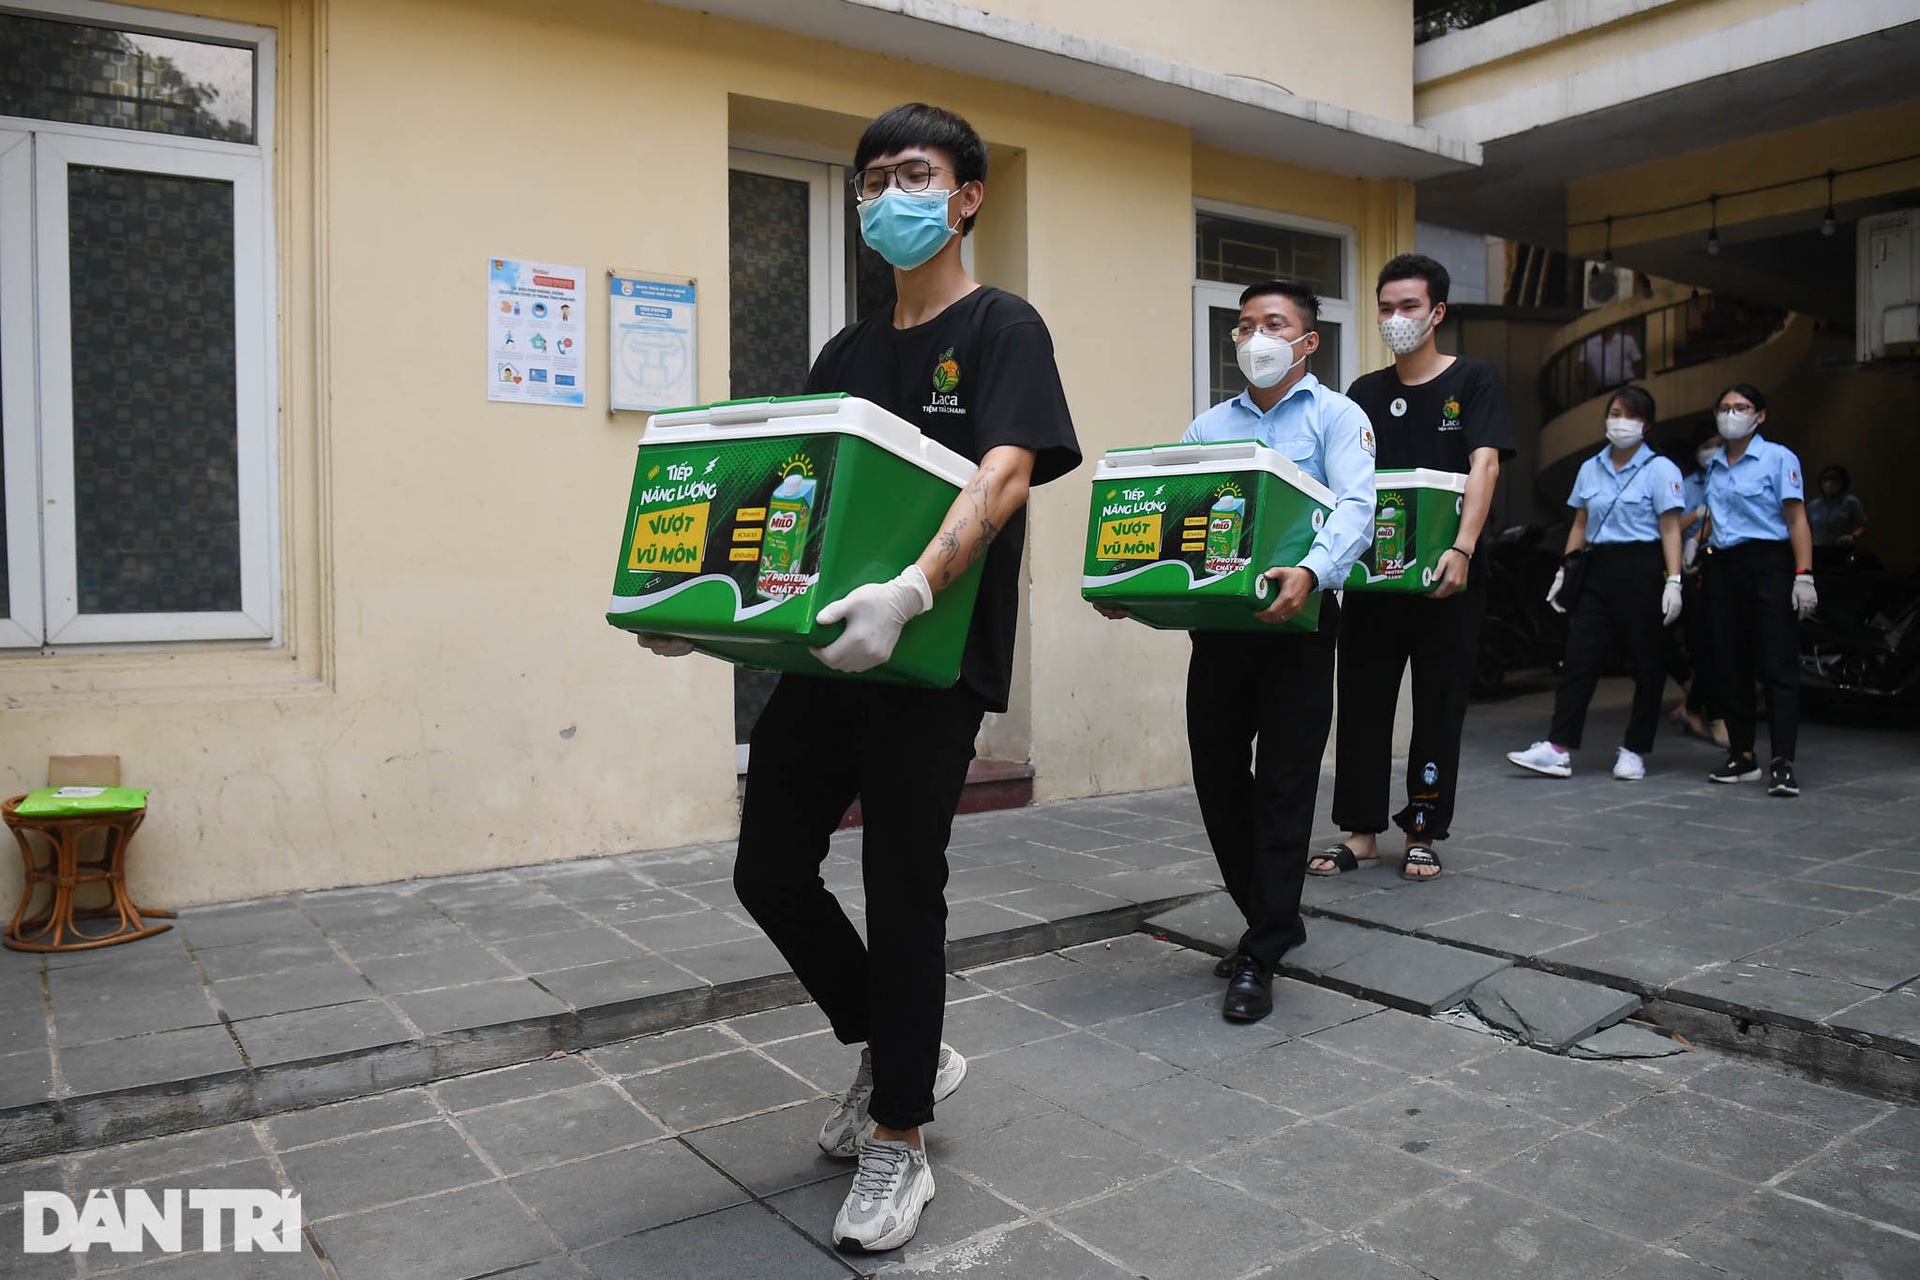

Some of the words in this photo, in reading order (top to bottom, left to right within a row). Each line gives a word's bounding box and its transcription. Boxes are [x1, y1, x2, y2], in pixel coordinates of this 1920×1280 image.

[667, 461, 694, 482] TIẾP
[640, 485, 676, 506] NĂNG
[676, 480, 717, 502] LƯỢNG
[1122, 487, 1146, 501] TIẾP
[1102, 503, 1132, 517] NĂNG
[1133, 500, 1167, 514] LƯỢNG
[649, 512, 694, 536] VƯỢT
[770, 518, 793, 528] MILO
[1111, 521, 1151, 537] VƯỢT
[1212, 522, 1230, 530] MILO
[637, 543, 658, 564] VŨ
[659, 542, 698, 565] MÔN
[1103, 541, 1121, 555] VŨ
[1123, 540, 1156, 555] MÔN
[1386, 559, 1402, 570] 2X
[772, 572, 809, 583] PROTEIN
